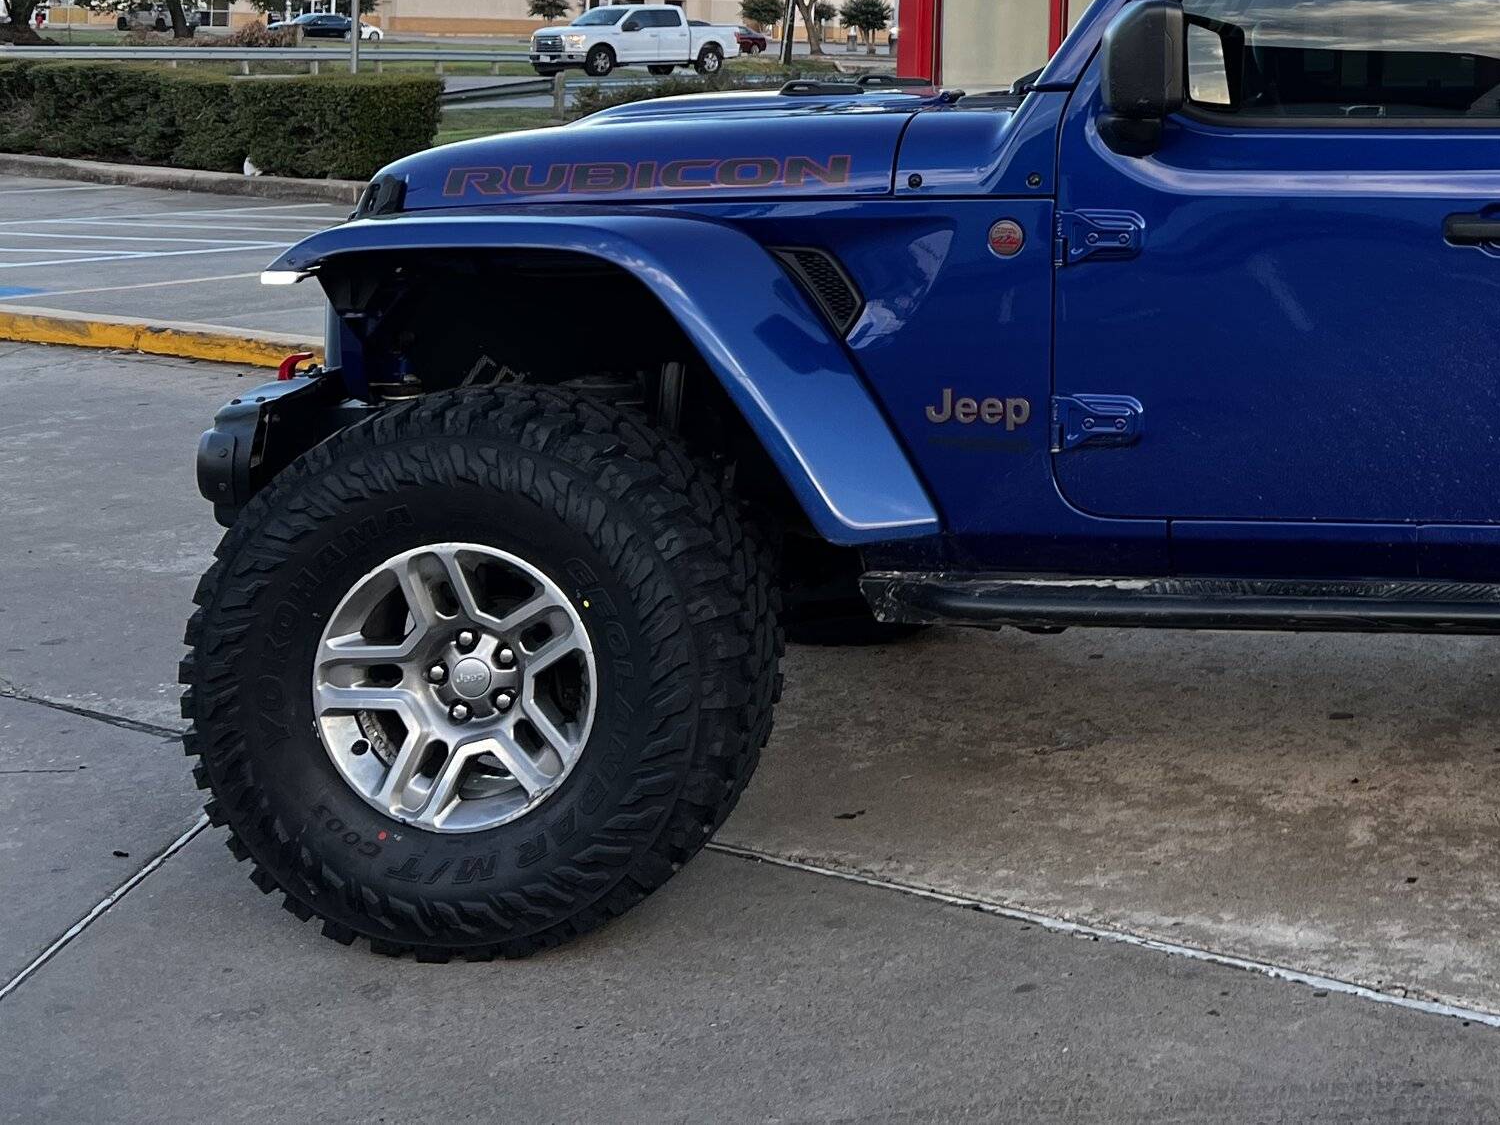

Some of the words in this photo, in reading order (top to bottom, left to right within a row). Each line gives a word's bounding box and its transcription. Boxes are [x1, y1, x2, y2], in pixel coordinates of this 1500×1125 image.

[442, 154, 852, 196] RUBICON
[925, 388, 1031, 431] Jeep
[259, 504, 415, 747] YOKOHAMA
